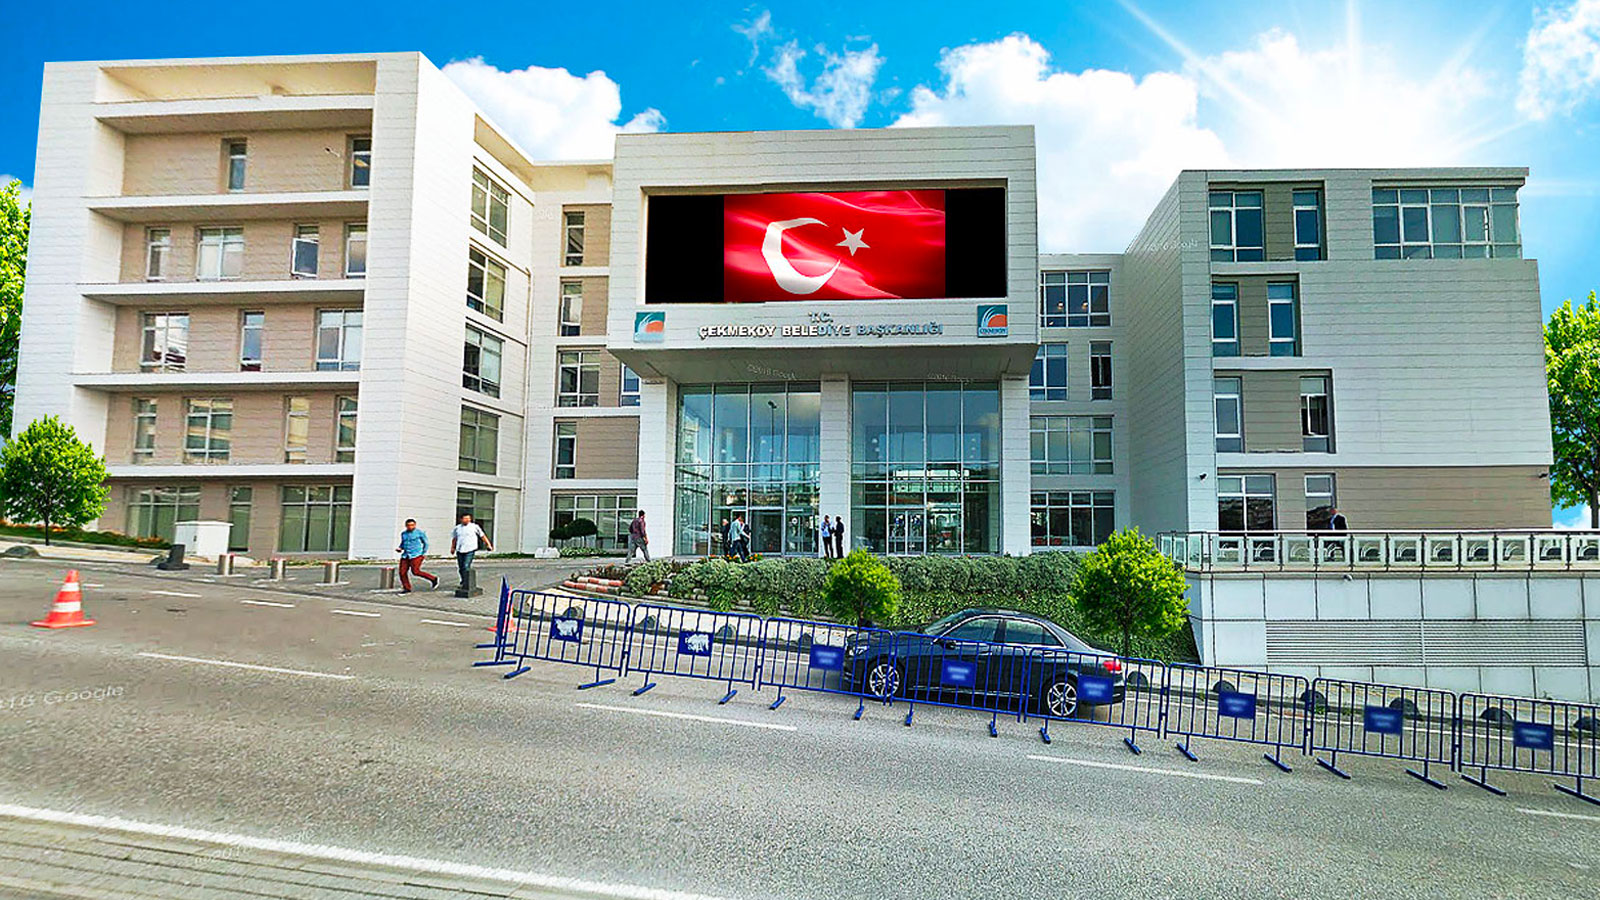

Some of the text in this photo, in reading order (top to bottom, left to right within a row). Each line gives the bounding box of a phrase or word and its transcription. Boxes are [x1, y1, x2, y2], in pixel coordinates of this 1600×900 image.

[698, 321, 944, 340] ÇEKMEKÖY BELEDİYE BAŞKANLIĞI
